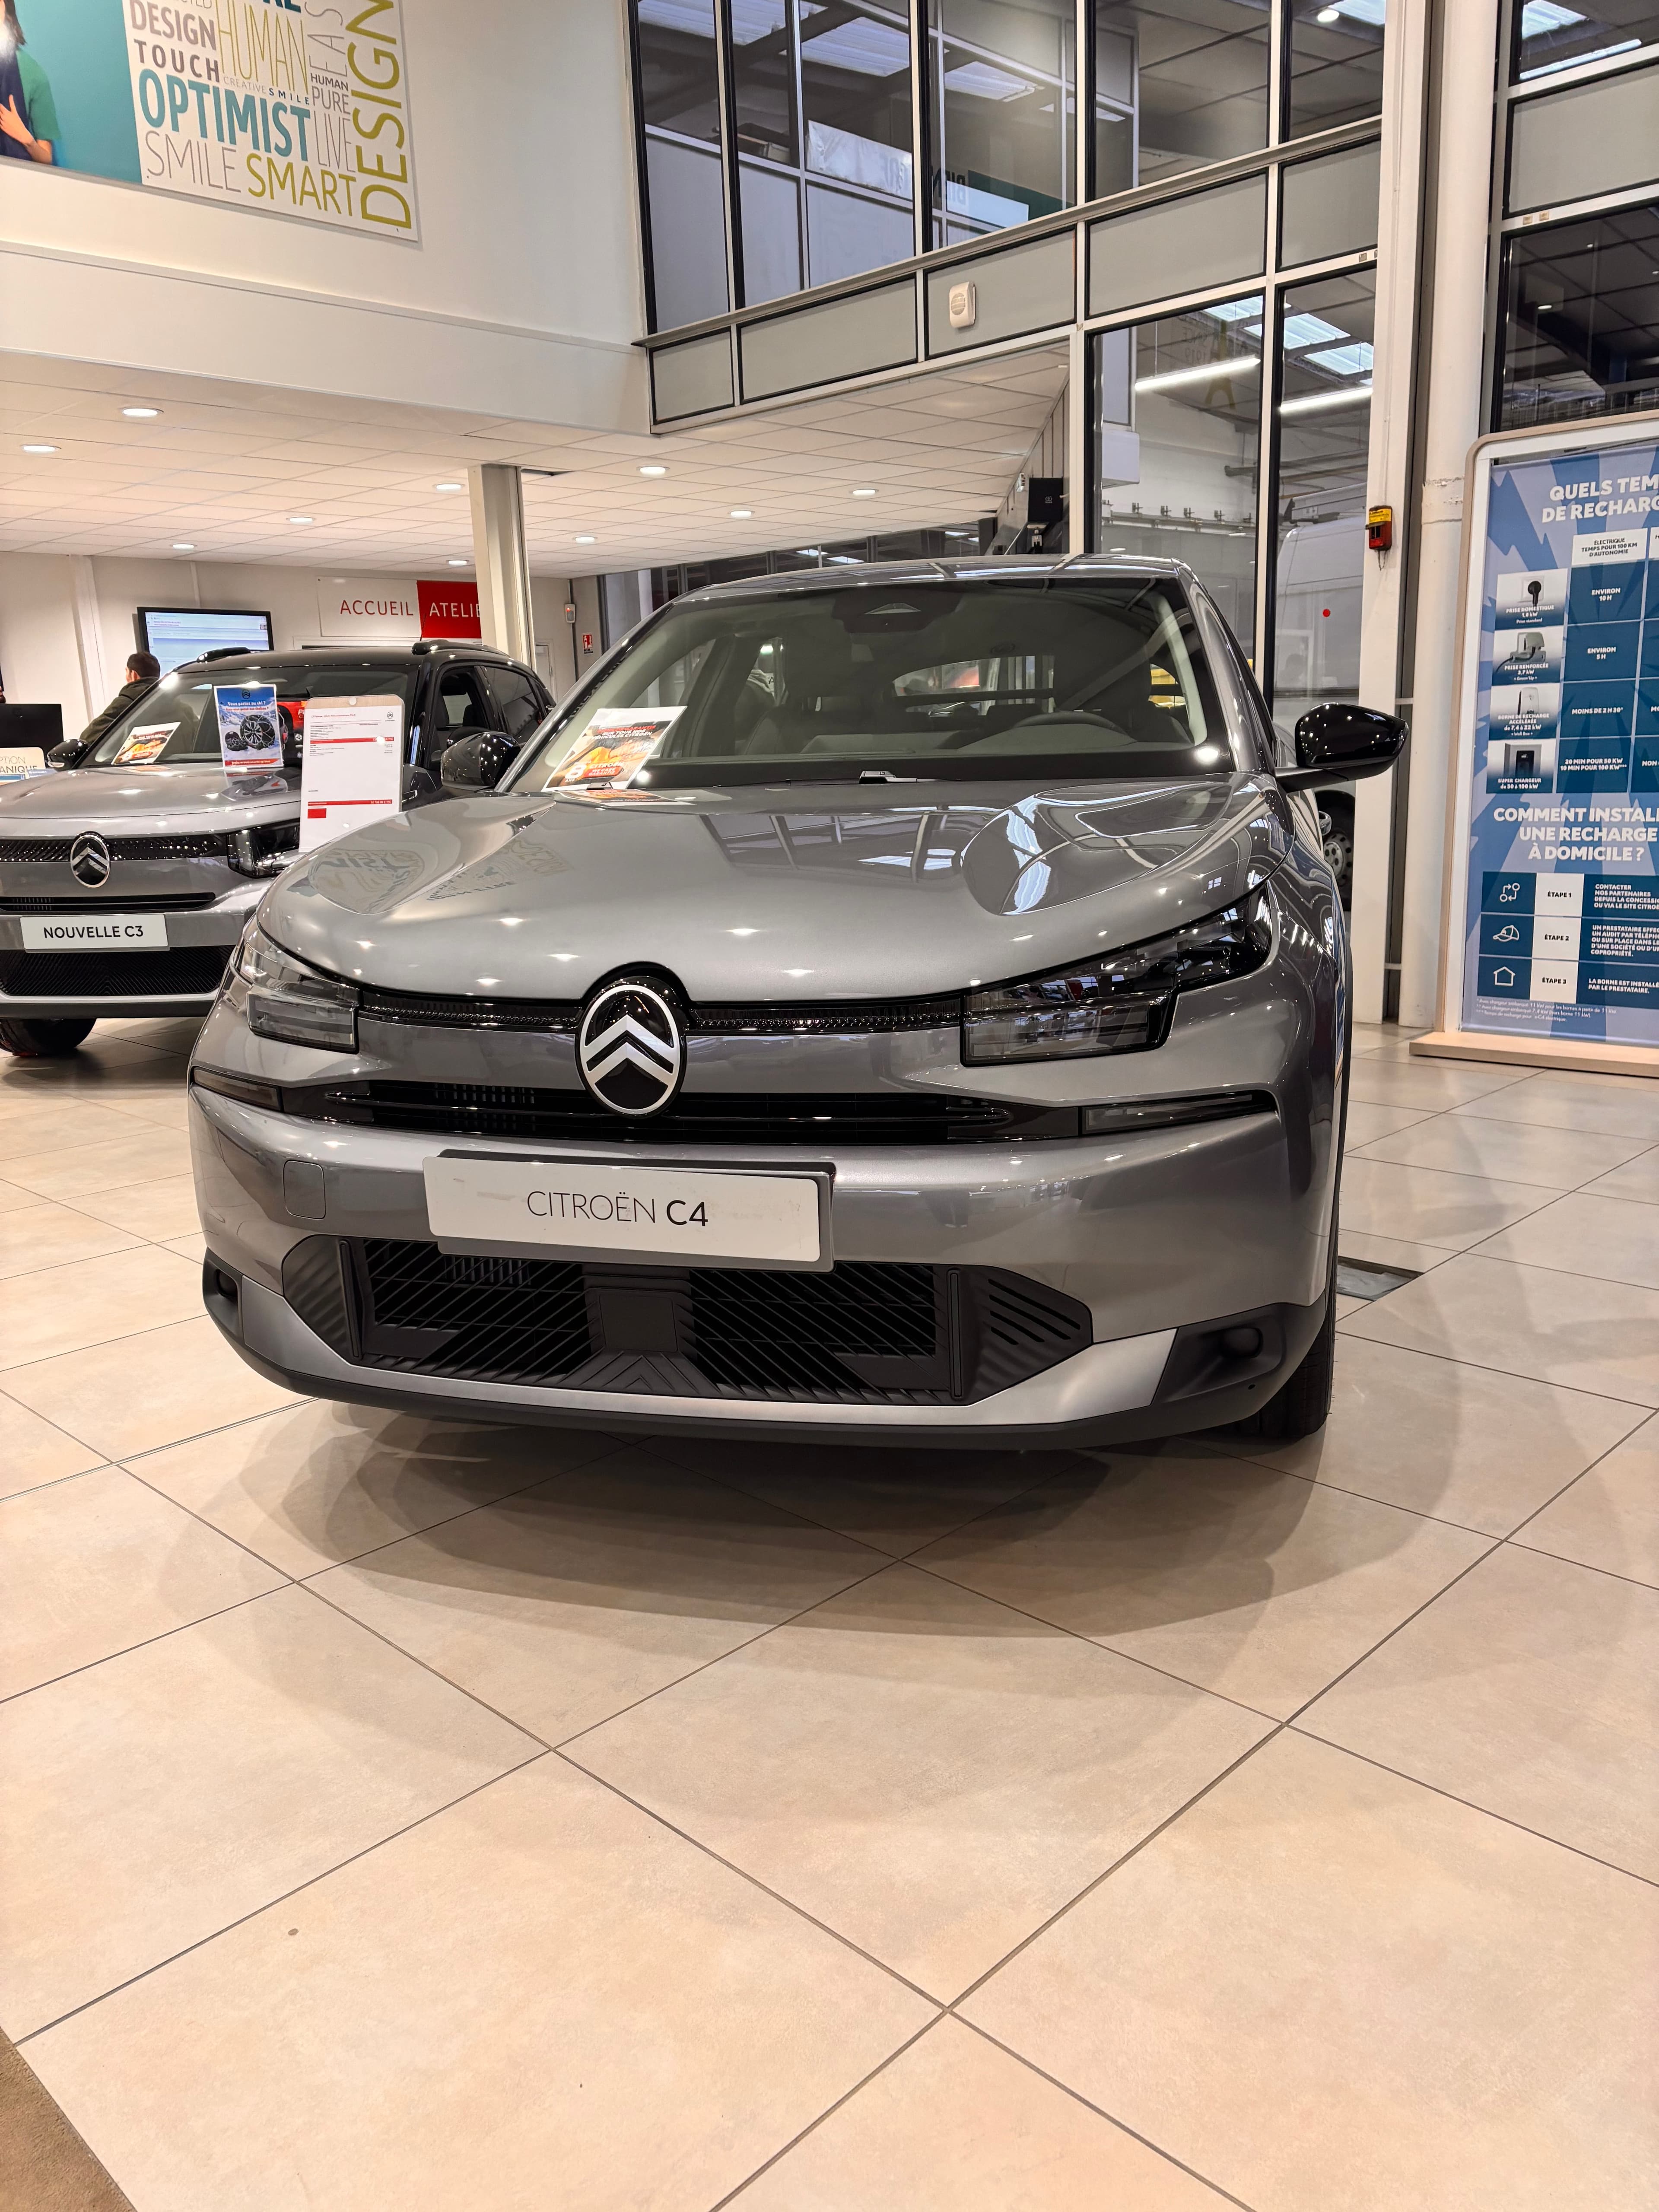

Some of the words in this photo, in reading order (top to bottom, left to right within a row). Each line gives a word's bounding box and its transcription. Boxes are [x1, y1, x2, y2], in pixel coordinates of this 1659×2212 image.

[130, 0, 216, 51] DESIGN
[216, 0, 308, 95] HUMAN
[134, 38, 220, 83] TOUCH
[224, 76, 266, 94] CREATIVE
[311, 73, 349, 91] HUMAN
[269, 88, 309, 105] SMILE
[311, 86, 350, 114] PURE
[139, 68, 310, 162] OPTIMIST
[346, 0, 411, 229] DESIGN
[314, 111, 356, 172] LIVE
[146, 130, 241, 192] SMILE
[246, 153, 356, 216] SMART
[1550, 480, 1612, 501] QUELS
[1618, 474, 1659, 493] TEM
[1542, 506, 1566, 523] DE
[1589, 549, 1628, 557] D'AUTONOMIE
[1592, 588, 1621, 596] ENVIRON
[340, 600, 413, 616] ACCUEIL
[565, 763, 587, 779] 8
[1494, 807, 1587, 822] COMMENT
[1519, 826, 1555, 841] UNE
[1559, 827, 1658, 842] RECHARGE
[1528, 842, 1541, 860] À
[1545, 846, 1633, 861] DOMICILE
[1636, 847, 1644, 861] ?
[43, 926, 121, 938] NOUVELLE
[124, 925, 143, 937] C3
[527, 1191, 656, 1224] CITROËN
[666, 1200, 709, 1227] C4
